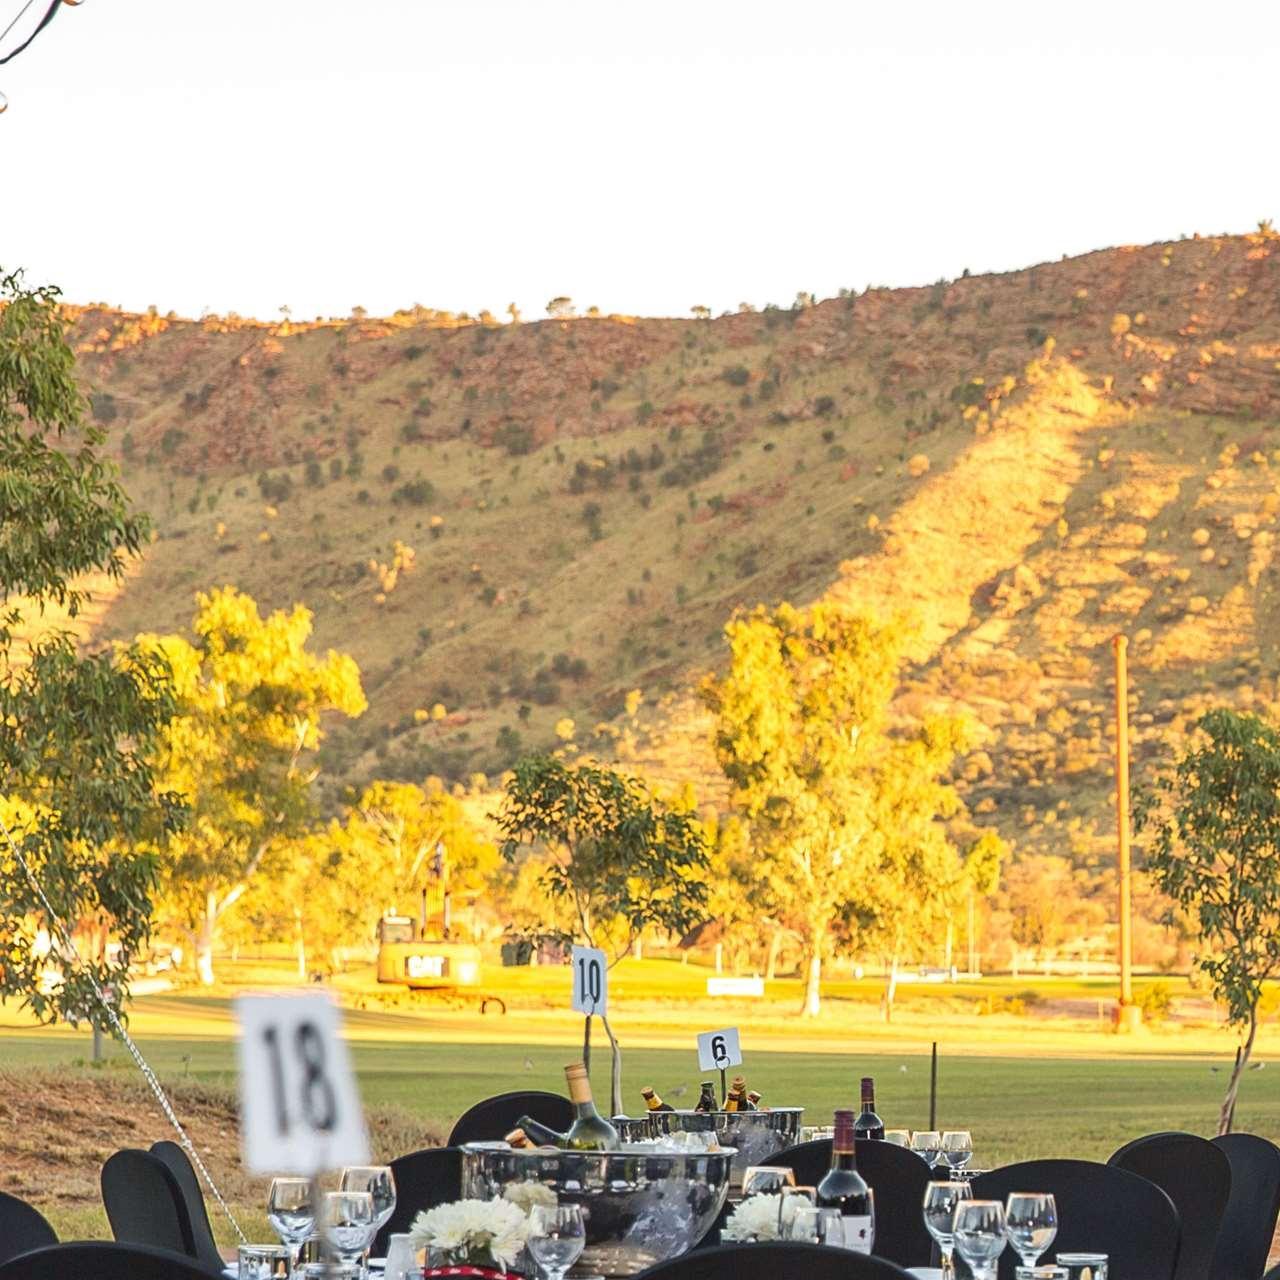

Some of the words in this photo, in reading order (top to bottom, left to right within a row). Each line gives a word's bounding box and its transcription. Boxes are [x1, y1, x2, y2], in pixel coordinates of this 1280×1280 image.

[578, 957, 600, 1004] 10
[711, 1035, 727, 1062] 6
[262, 1020, 338, 1137] 18
